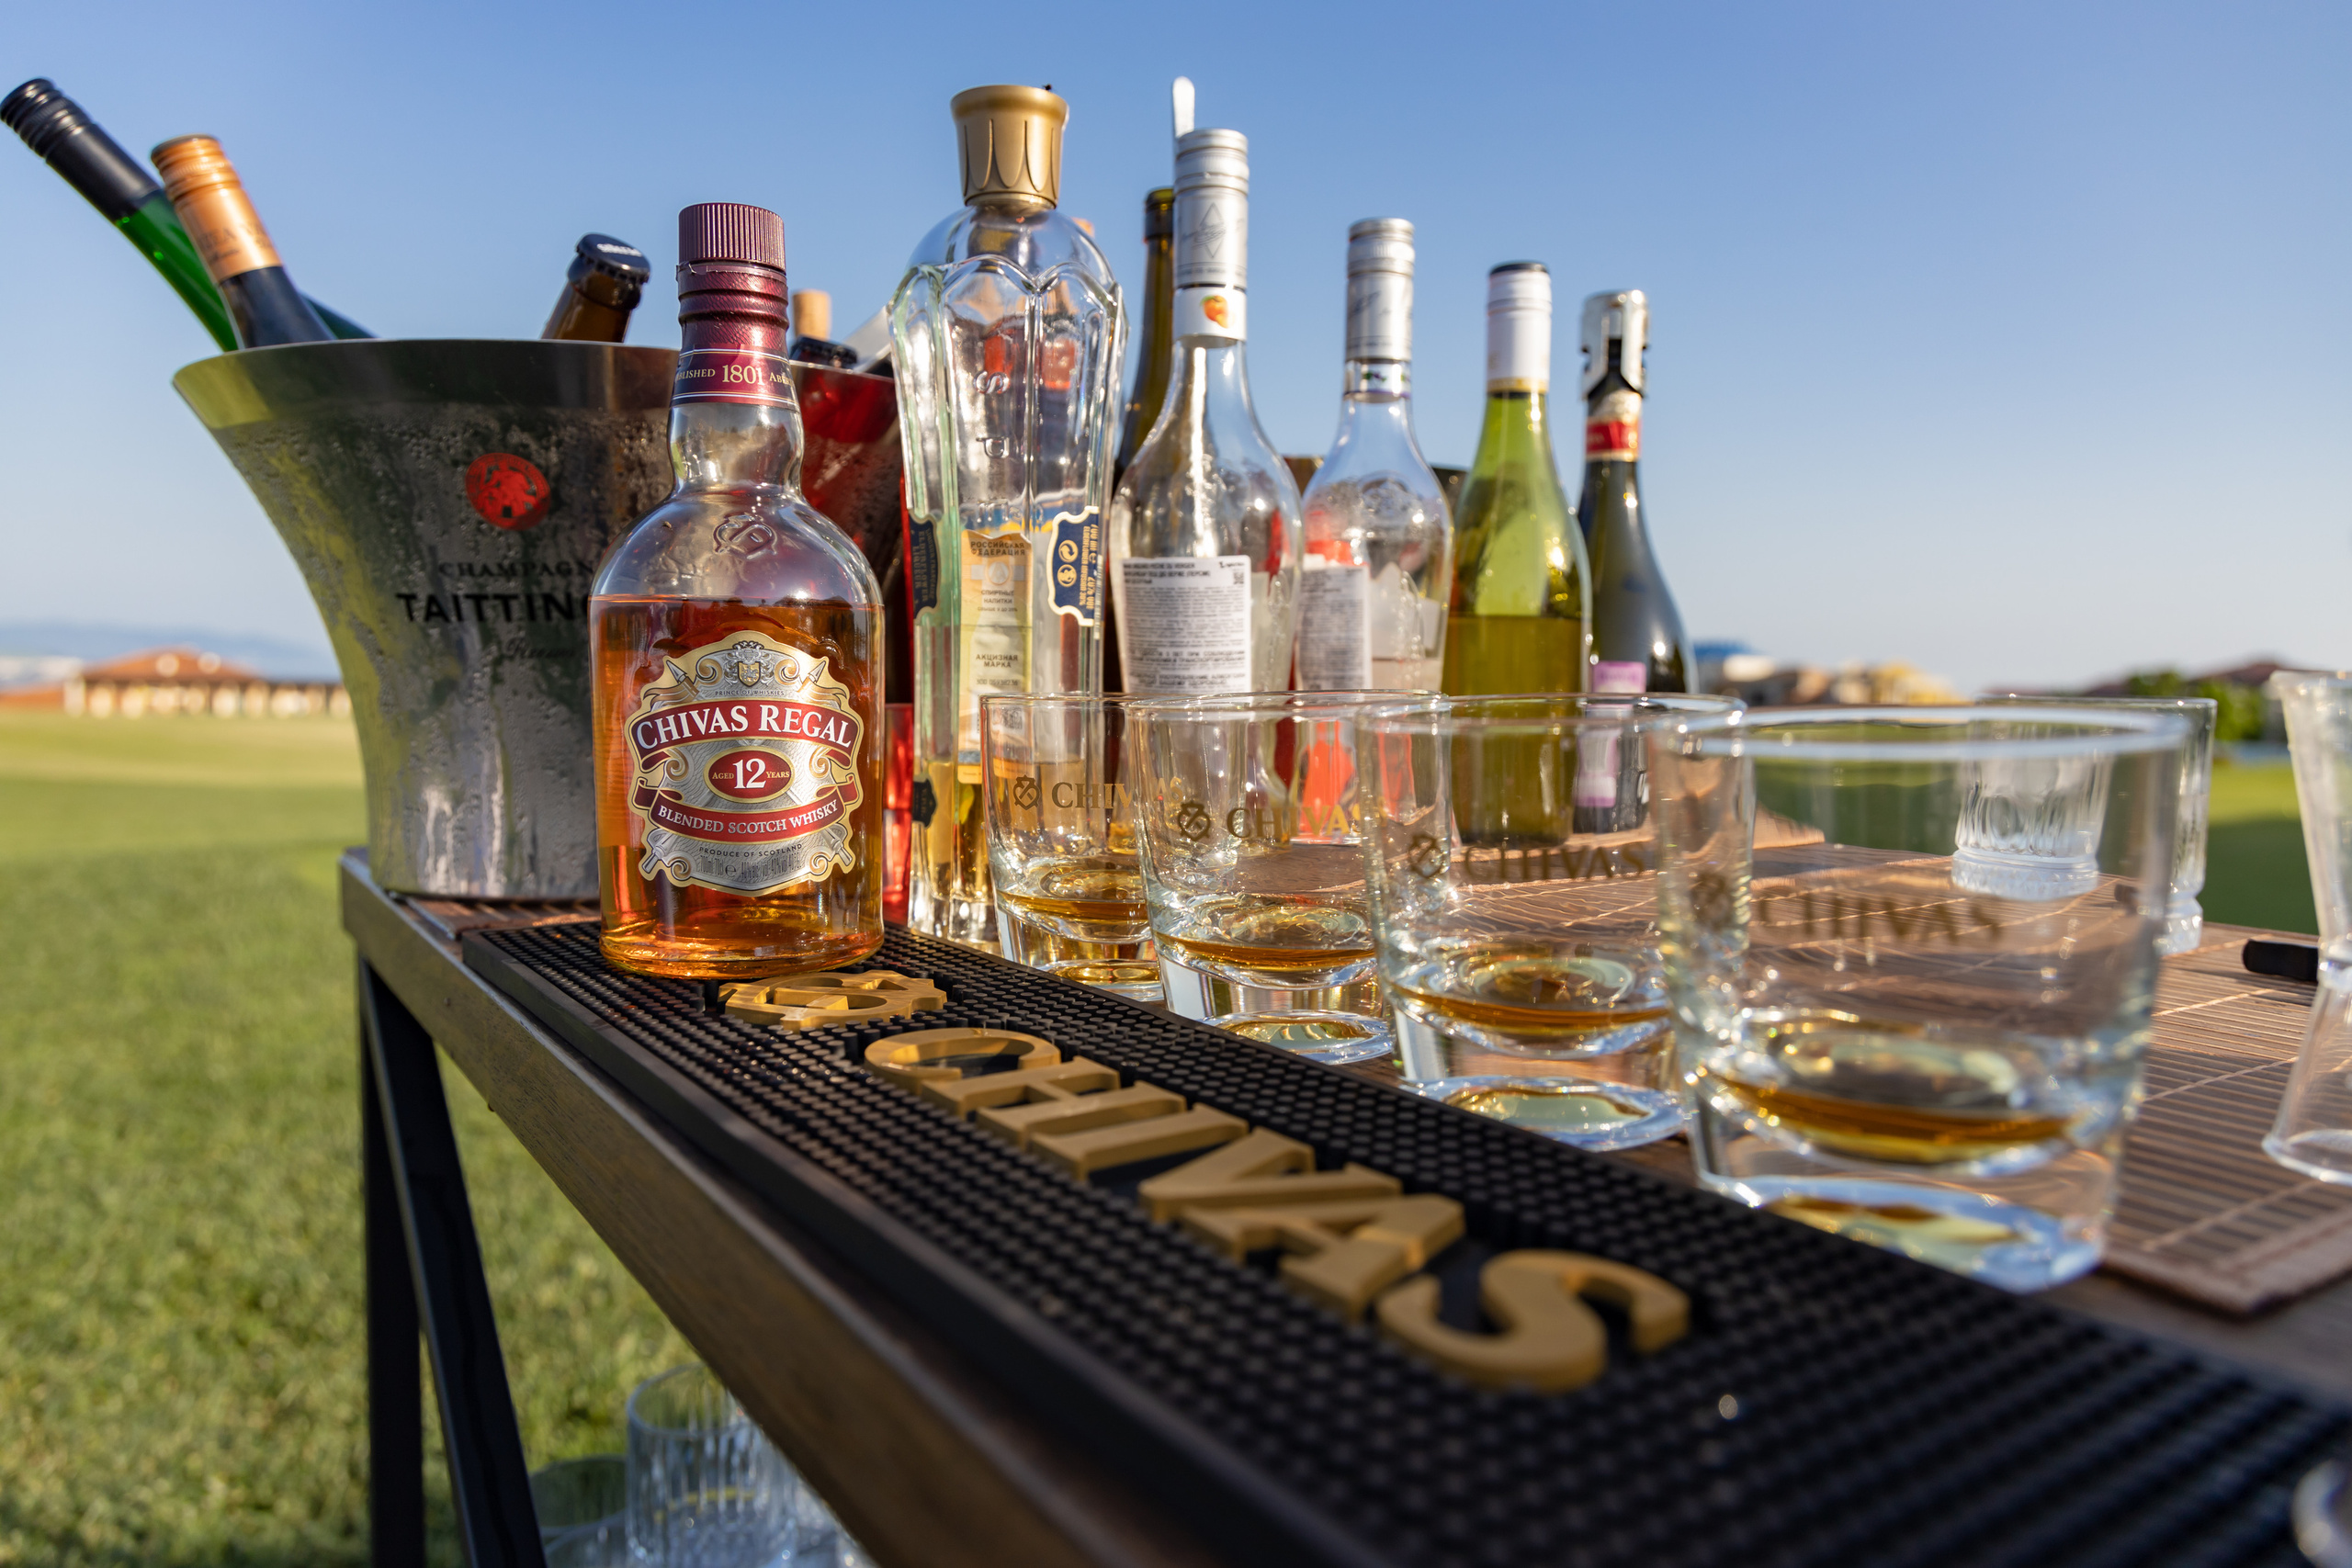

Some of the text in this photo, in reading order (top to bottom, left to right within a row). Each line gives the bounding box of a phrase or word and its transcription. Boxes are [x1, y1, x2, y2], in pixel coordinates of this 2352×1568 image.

[677, 368, 716, 380] BLISHED
[722, 365, 765, 386] 1801
[970, 540, 1024, 548] РОССИЙСКАЯ
[395, 592, 589, 623] TAITTIN
[637, 705, 852, 750] CHIVAS REGAL
[712, 758, 790, 789] AGED 12 YEARS
[658, 799, 838, 834] BLENDED SCOTCH WHISKY
[699, 847, 740, 857] PRODUCE
[759, 844, 802, 856] SCOTLAND
[864, 1027, 1690, 1391] CHIVAS
